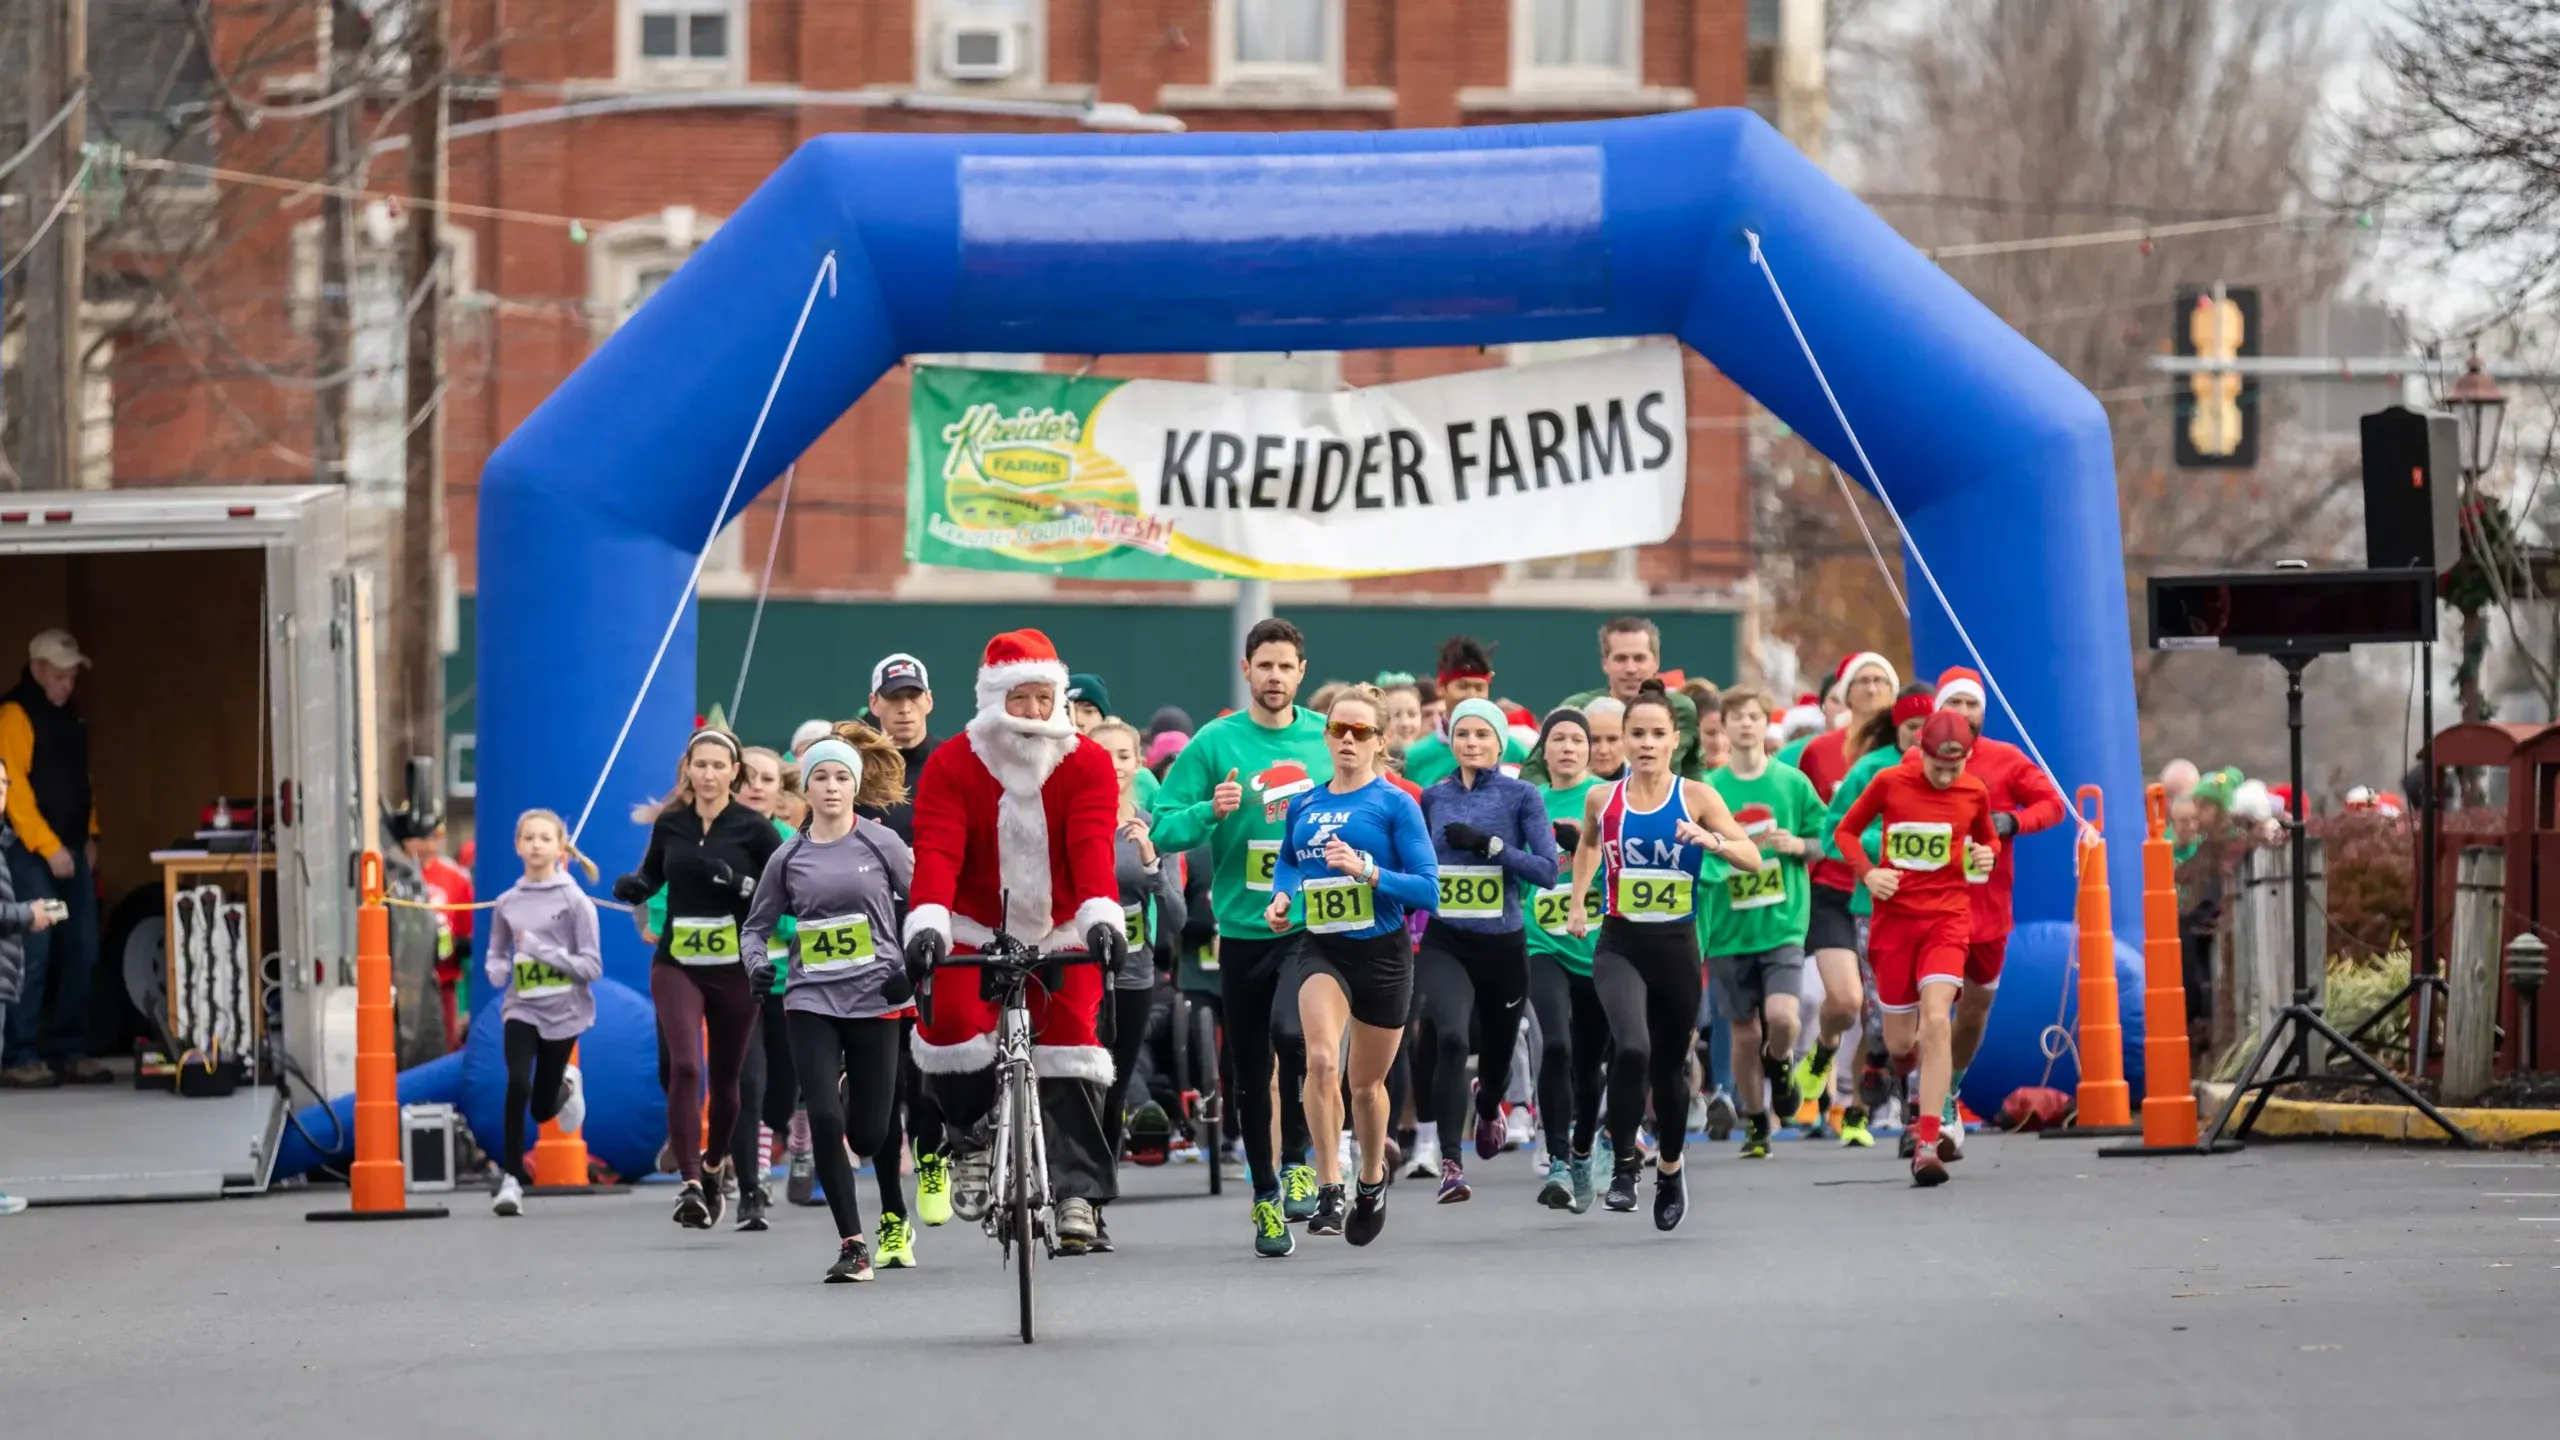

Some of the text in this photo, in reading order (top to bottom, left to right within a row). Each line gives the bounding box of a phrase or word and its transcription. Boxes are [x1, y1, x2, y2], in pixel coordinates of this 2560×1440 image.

[943, 403, 1081, 482] Kreider
[1160, 390, 1674, 513] KREIDER FARMS
[992, 457, 1062, 475] FARMS
[1094, 508, 1174, 547] Fresh!
[1307, 812, 1352, 824] F&M
[1604, 837, 1684, 870] F&M
[1891, 832, 1946, 858] 106
[1439, 877, 1500, 905] 380
[1632, 880, 1678, 909] 94
[1730, 870, 1780, 898] 324
[1312, 887, 1361, 920] 181
[683, 929, 726, 952] 46
[812, 927, 857, 957] 45
